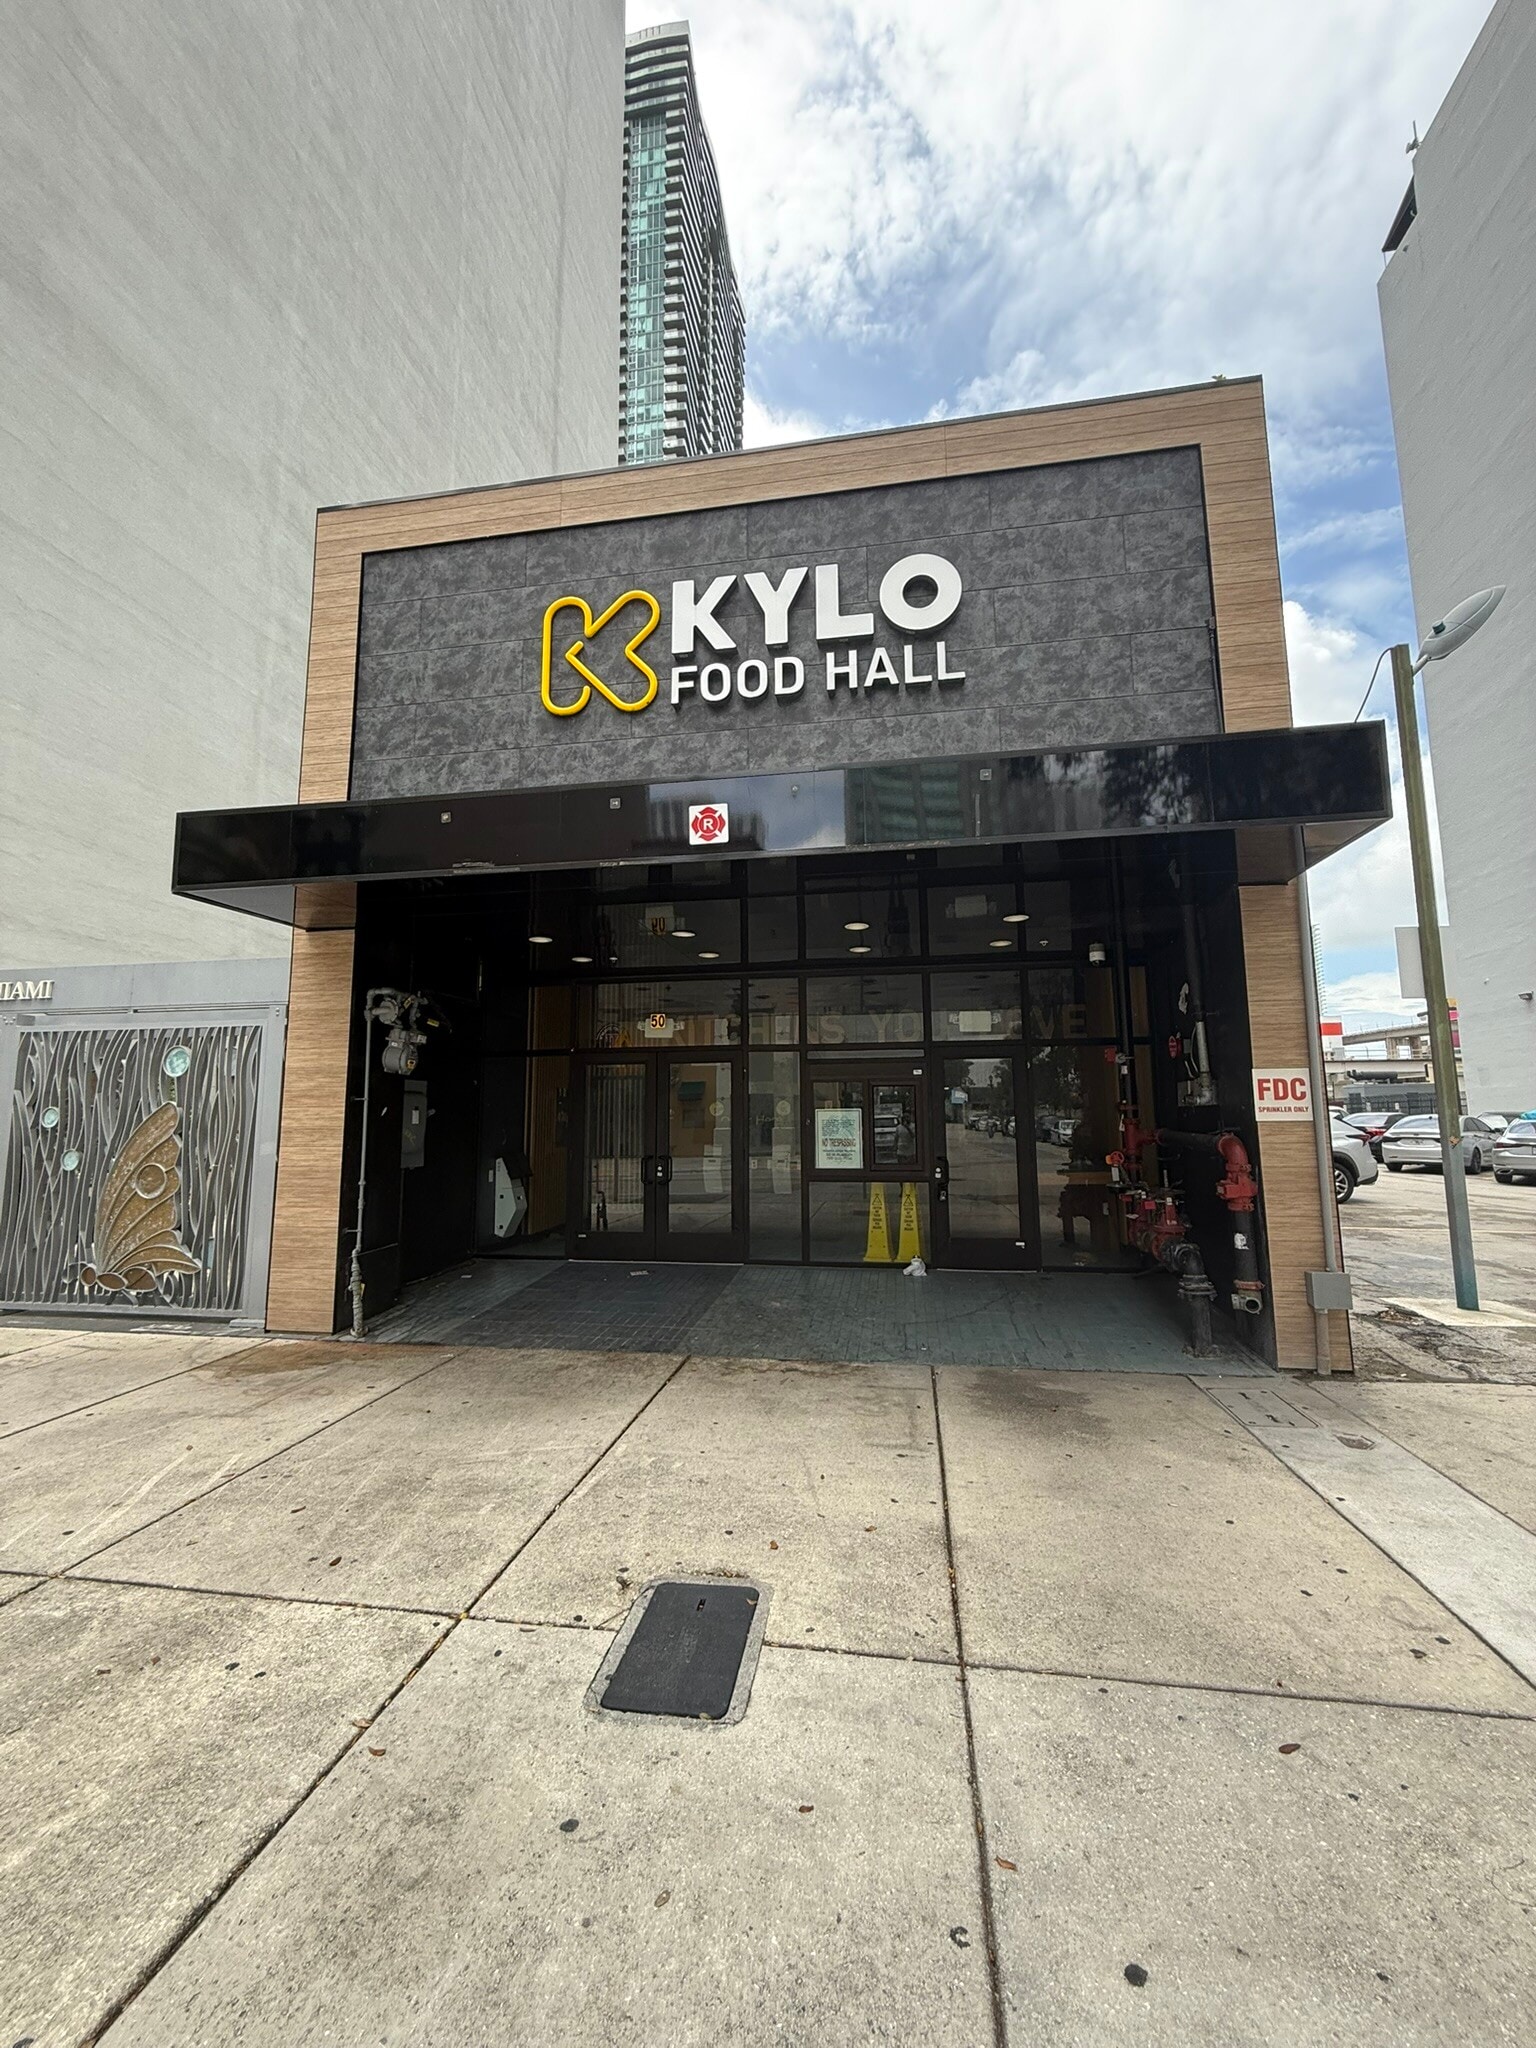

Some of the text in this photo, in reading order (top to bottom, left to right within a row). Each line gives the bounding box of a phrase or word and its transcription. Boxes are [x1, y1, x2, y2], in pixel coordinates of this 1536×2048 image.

[672, 553, 963, 656] KYLO
[671, 641, 966, 705] FOOD HALL
[703, 818, 715, 831] R
[0, 980, 55, 1001] IAMI
[651, 1014, 665, 1028] 50
[1257, 1077, 1307, 1101] FDC
